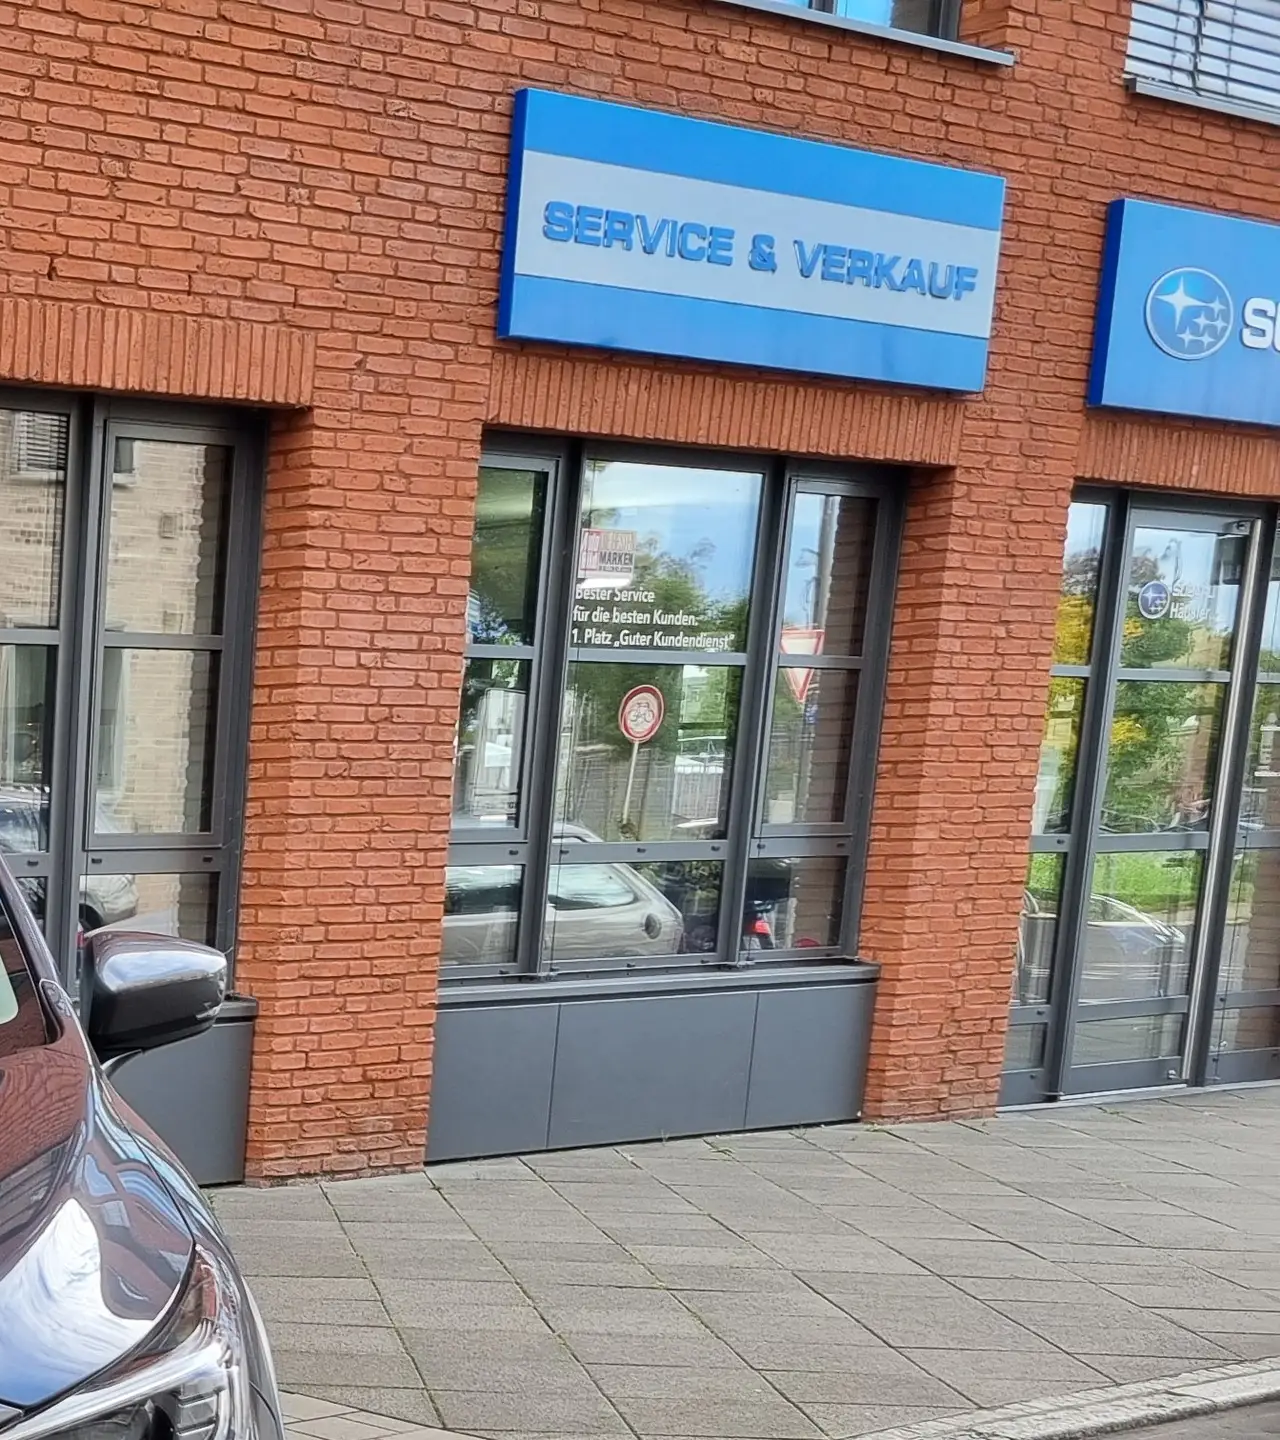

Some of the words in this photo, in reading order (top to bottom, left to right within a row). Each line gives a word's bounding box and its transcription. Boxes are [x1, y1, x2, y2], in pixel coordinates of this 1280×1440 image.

[542, 200, 735, 265] SERVICE
[748, 234, 777, 273] &
[793, 239, 979, 301] VERKAUF
[1241, 296, 1280, 352] S
[598, 551, 634, 566] MARKEN
[575, 584, 612, 600] Bester
[614, 587, 656, 603] Service
[572, 605, 590, 622] für
[592, 607, 611, 623] die
[612, 607, 651, 625] besten
[653, 609, 699, 626] Kunden.
[571, 628, 582, 644] 1.
[584, 628, 613, 645] Platz
